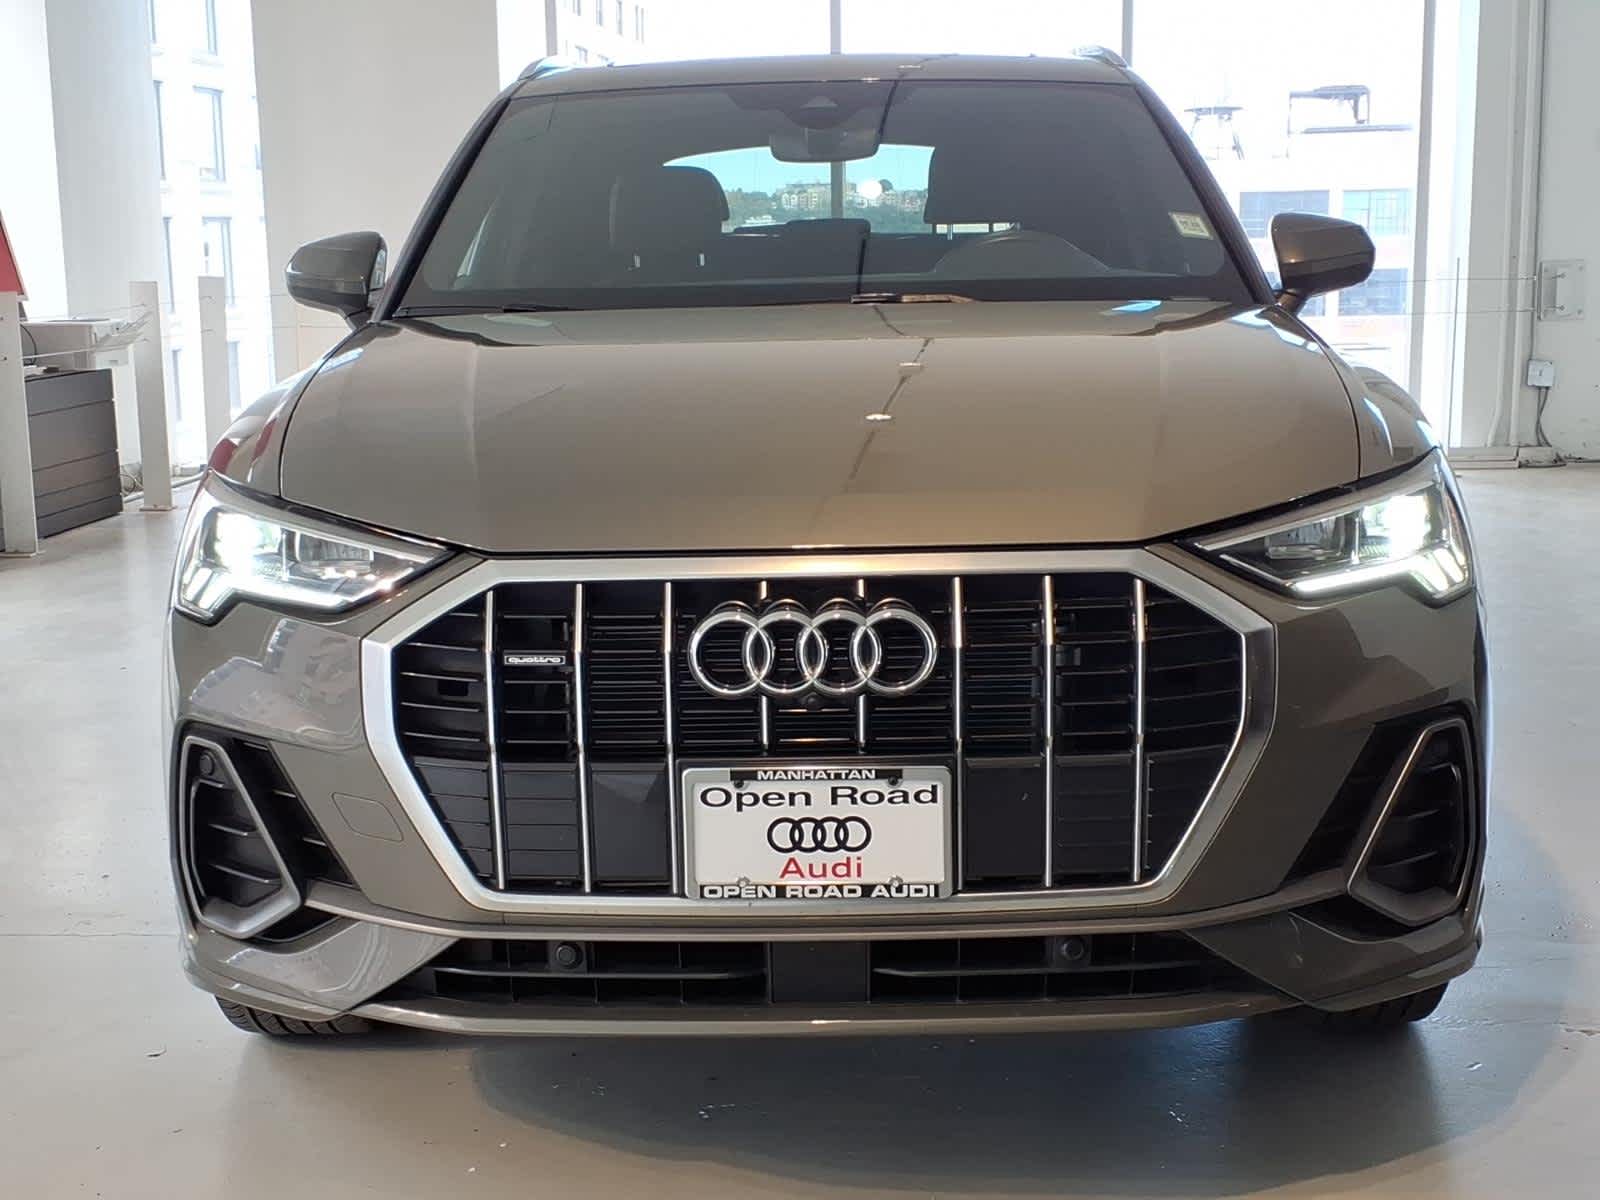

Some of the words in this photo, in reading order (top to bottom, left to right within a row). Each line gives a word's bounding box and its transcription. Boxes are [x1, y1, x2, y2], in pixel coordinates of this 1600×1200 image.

[508, 656, 561, 664] quattro
[757, 769, 876, 781] MANHATTAN
[700, 787, 812, 812] Open
[830, 785, 938, 806] Road
[779, 857, 862, 879] Audi
[703, 885, 776, 898] OPEN
[785, 885, 862, 898] ROAD
[872, 884, 935, 898] AUDI
